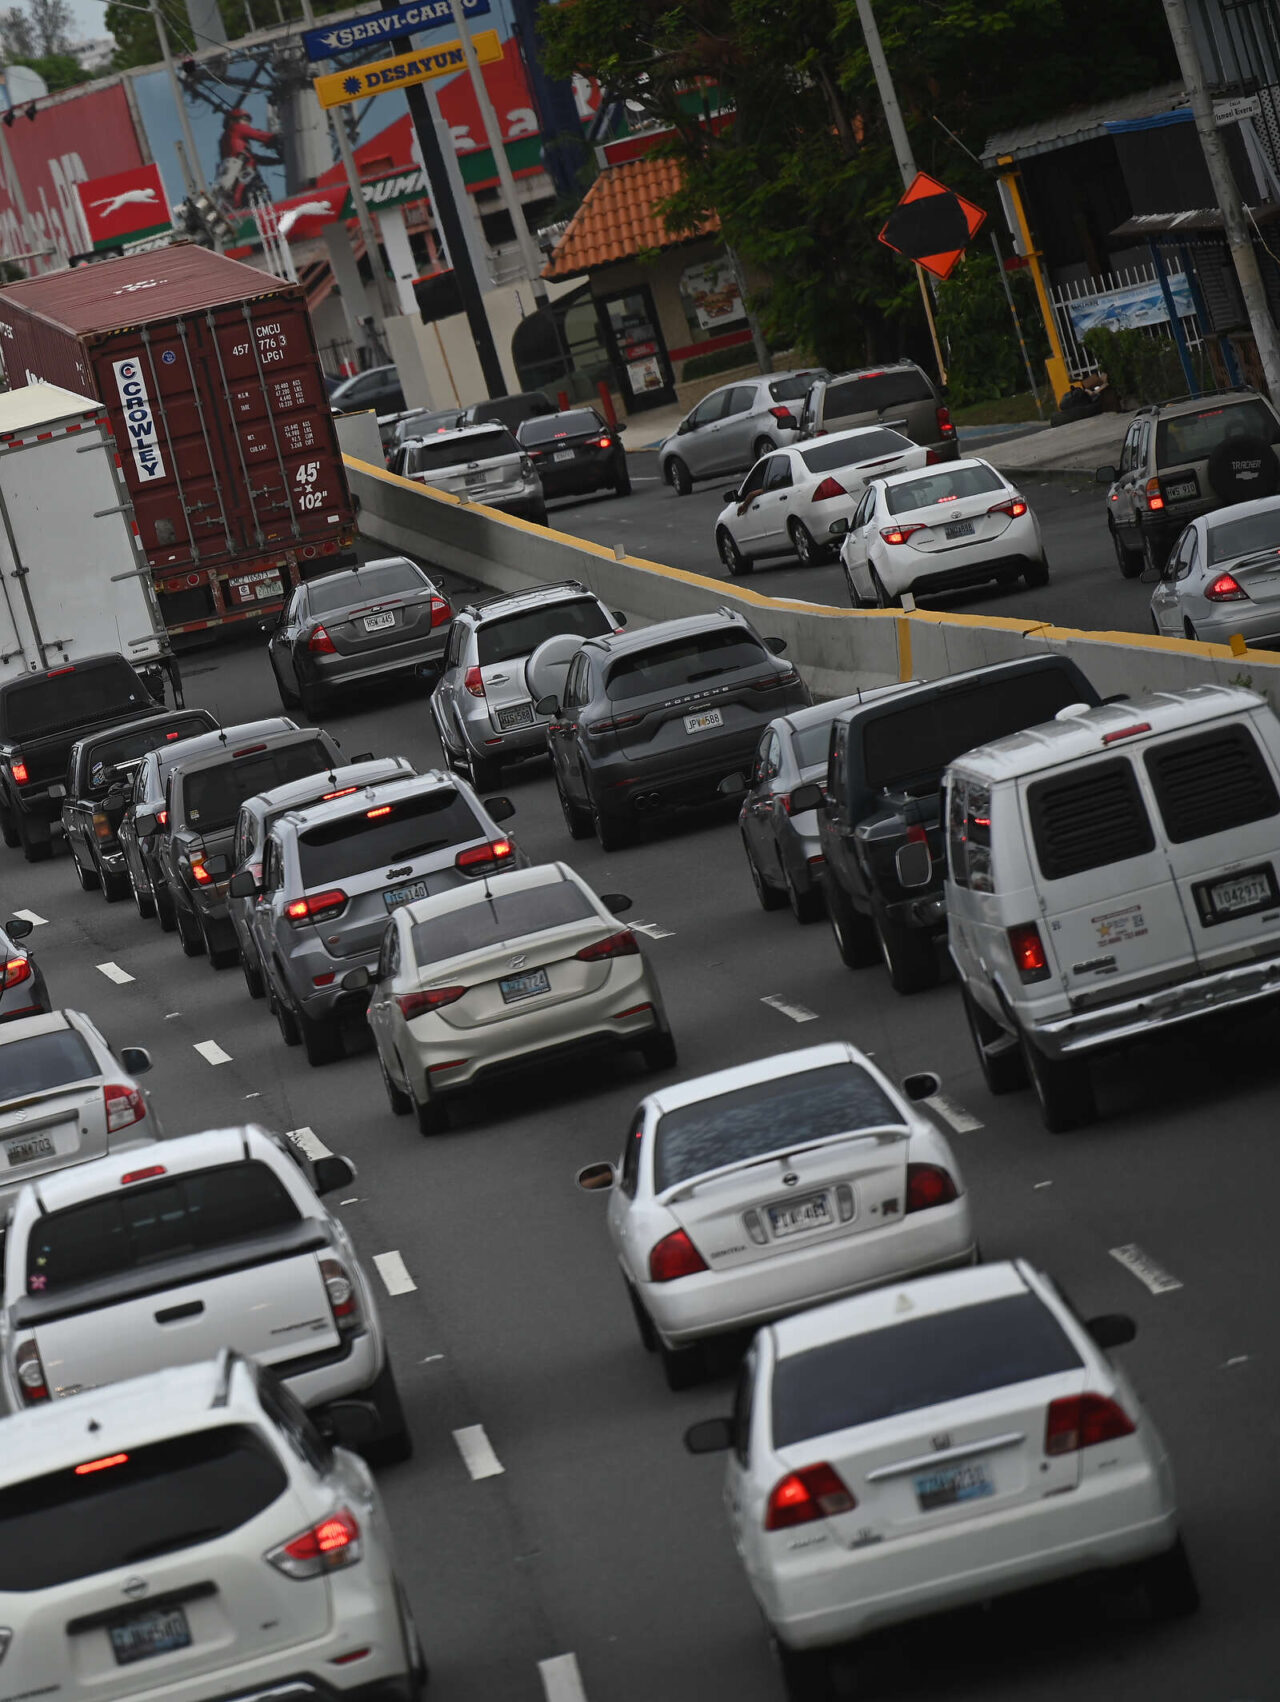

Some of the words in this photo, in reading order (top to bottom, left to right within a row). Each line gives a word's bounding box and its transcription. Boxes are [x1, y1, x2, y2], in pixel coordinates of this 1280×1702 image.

[340, 0, 478, 48] SERVI-CARO
[365, 47, 477, 88] DESAYUN
[256, 323, 280, 338] CMCU
[232, 344, 249, 356] 457
[258, 338, 276, 351] 776
[123, 382, 158, 477] CROWLEY
[1232, 460, 1261, 470] TRACKER
[664, 686, 728, 707] PORSCHE
[704, 714, 720, 726] 588
[386, 866, 413, 880] Jeep
[33, 1138, 52, 1152] 703
